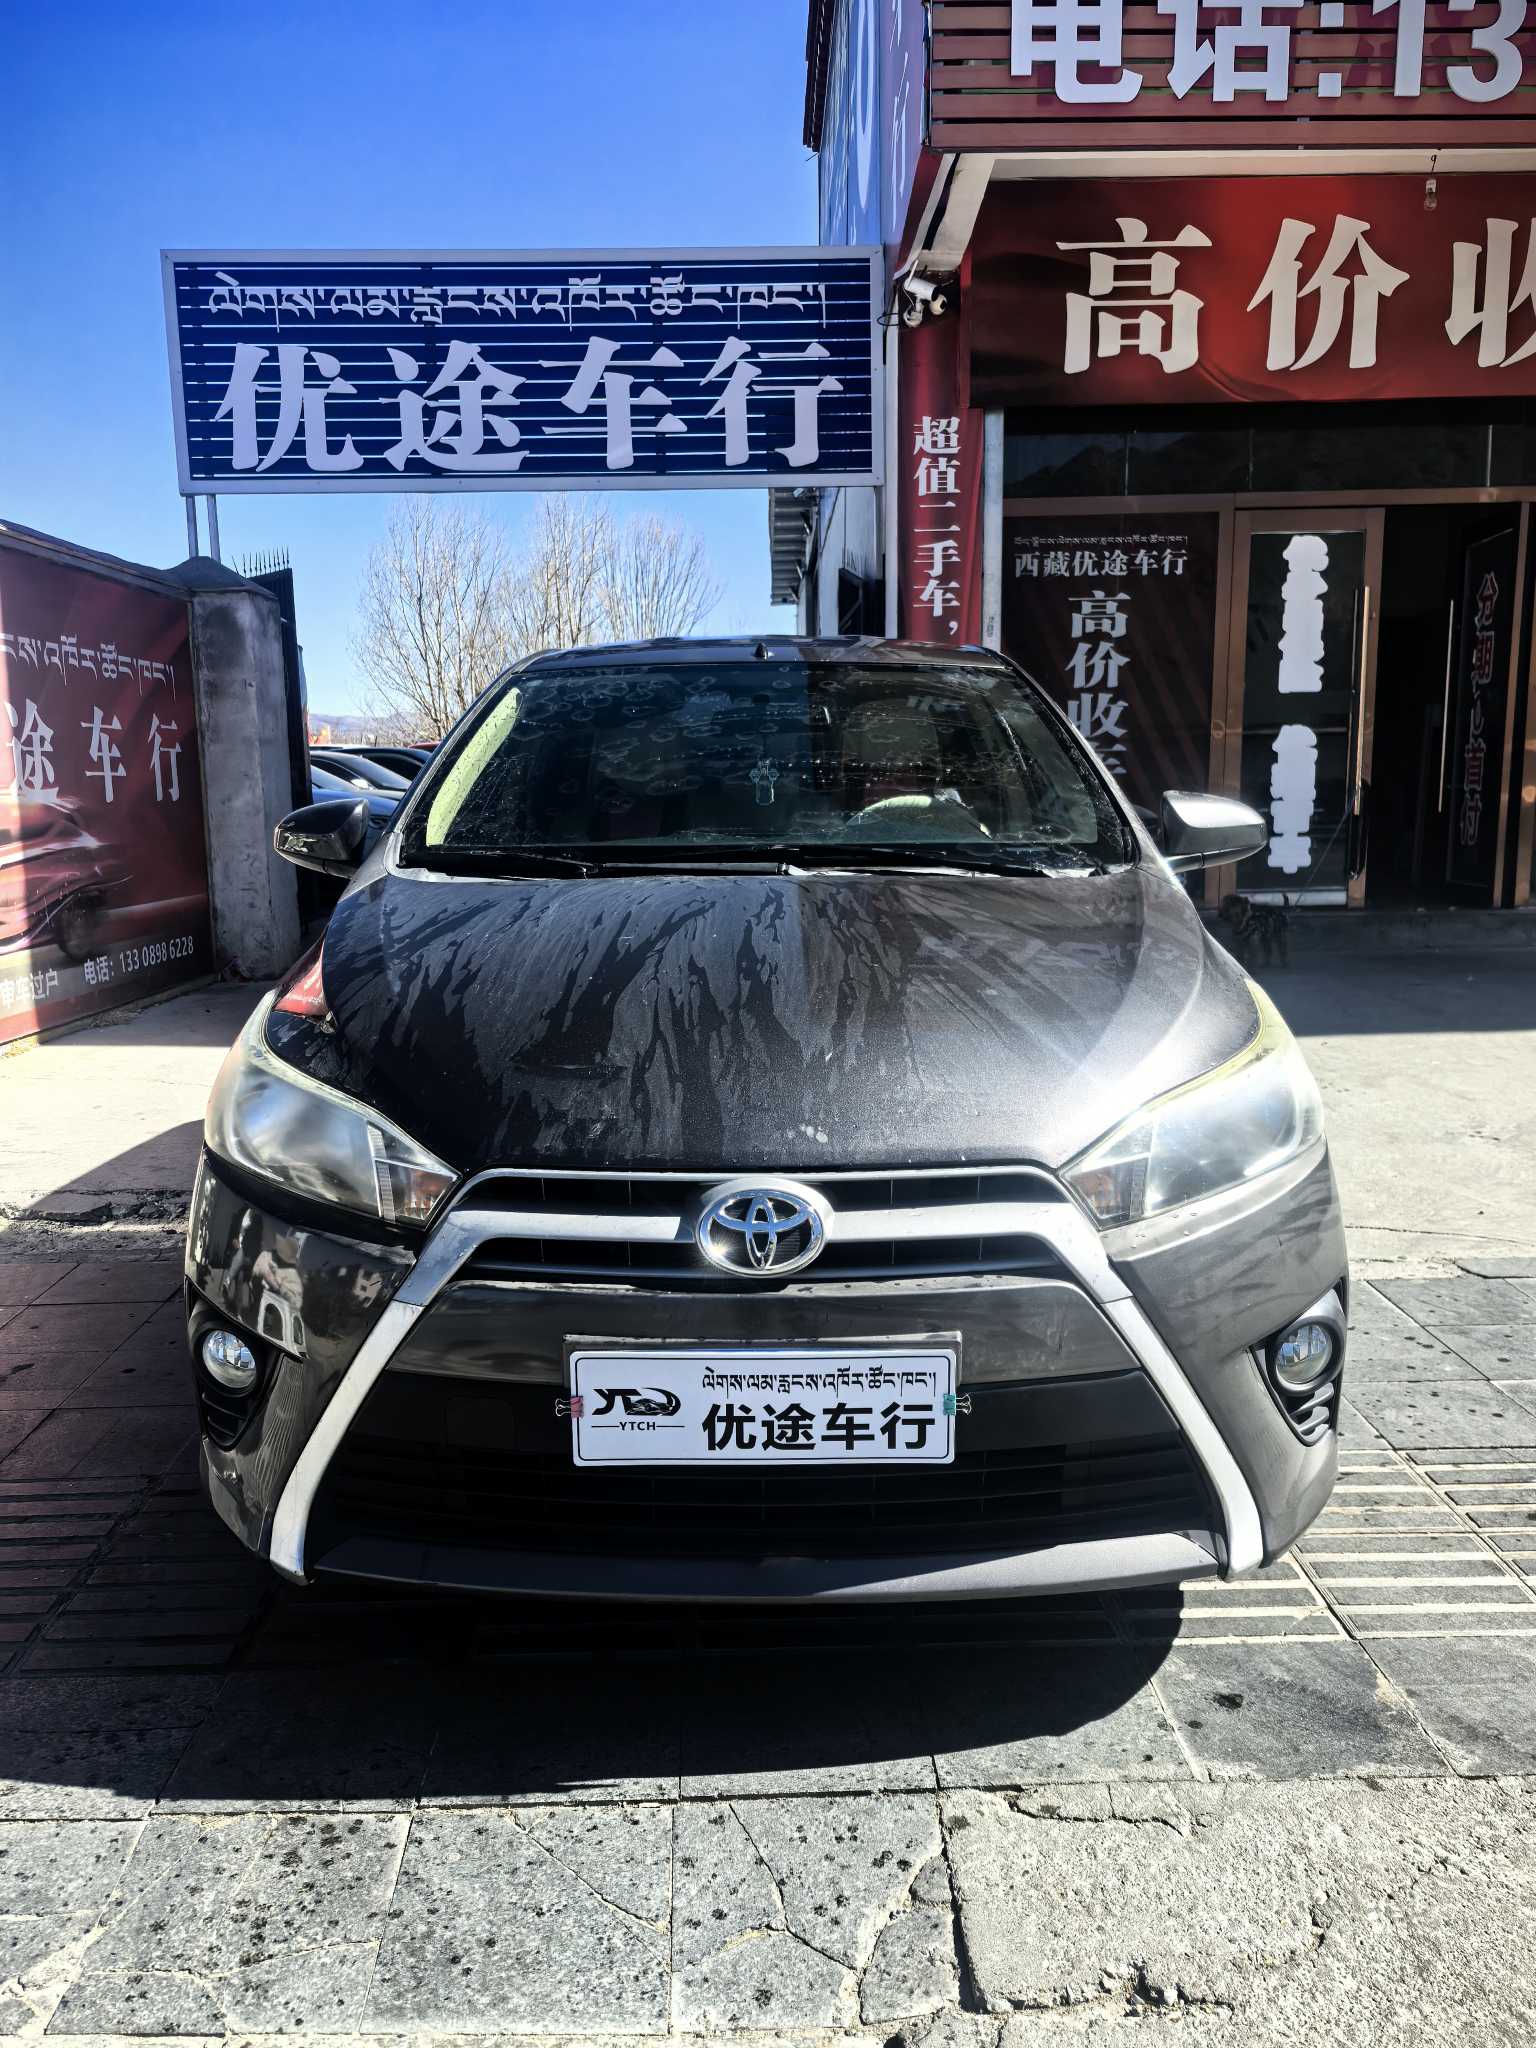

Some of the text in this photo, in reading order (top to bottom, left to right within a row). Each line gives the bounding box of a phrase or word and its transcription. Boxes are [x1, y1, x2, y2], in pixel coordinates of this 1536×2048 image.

[213, 335, 844, 472] 优途车行
[1014, 549, 1188, 577] 西藏优途车行
[4, 698, 182, 803] 途车行
[120, 948, 140, 973] 133
[142, 941, 168, 967] 0898
[169, 935, 194, 960] 6228
[619, 1421, 656, 1431] YTCH
[701, 1401, 936, 1451] 优途车行
